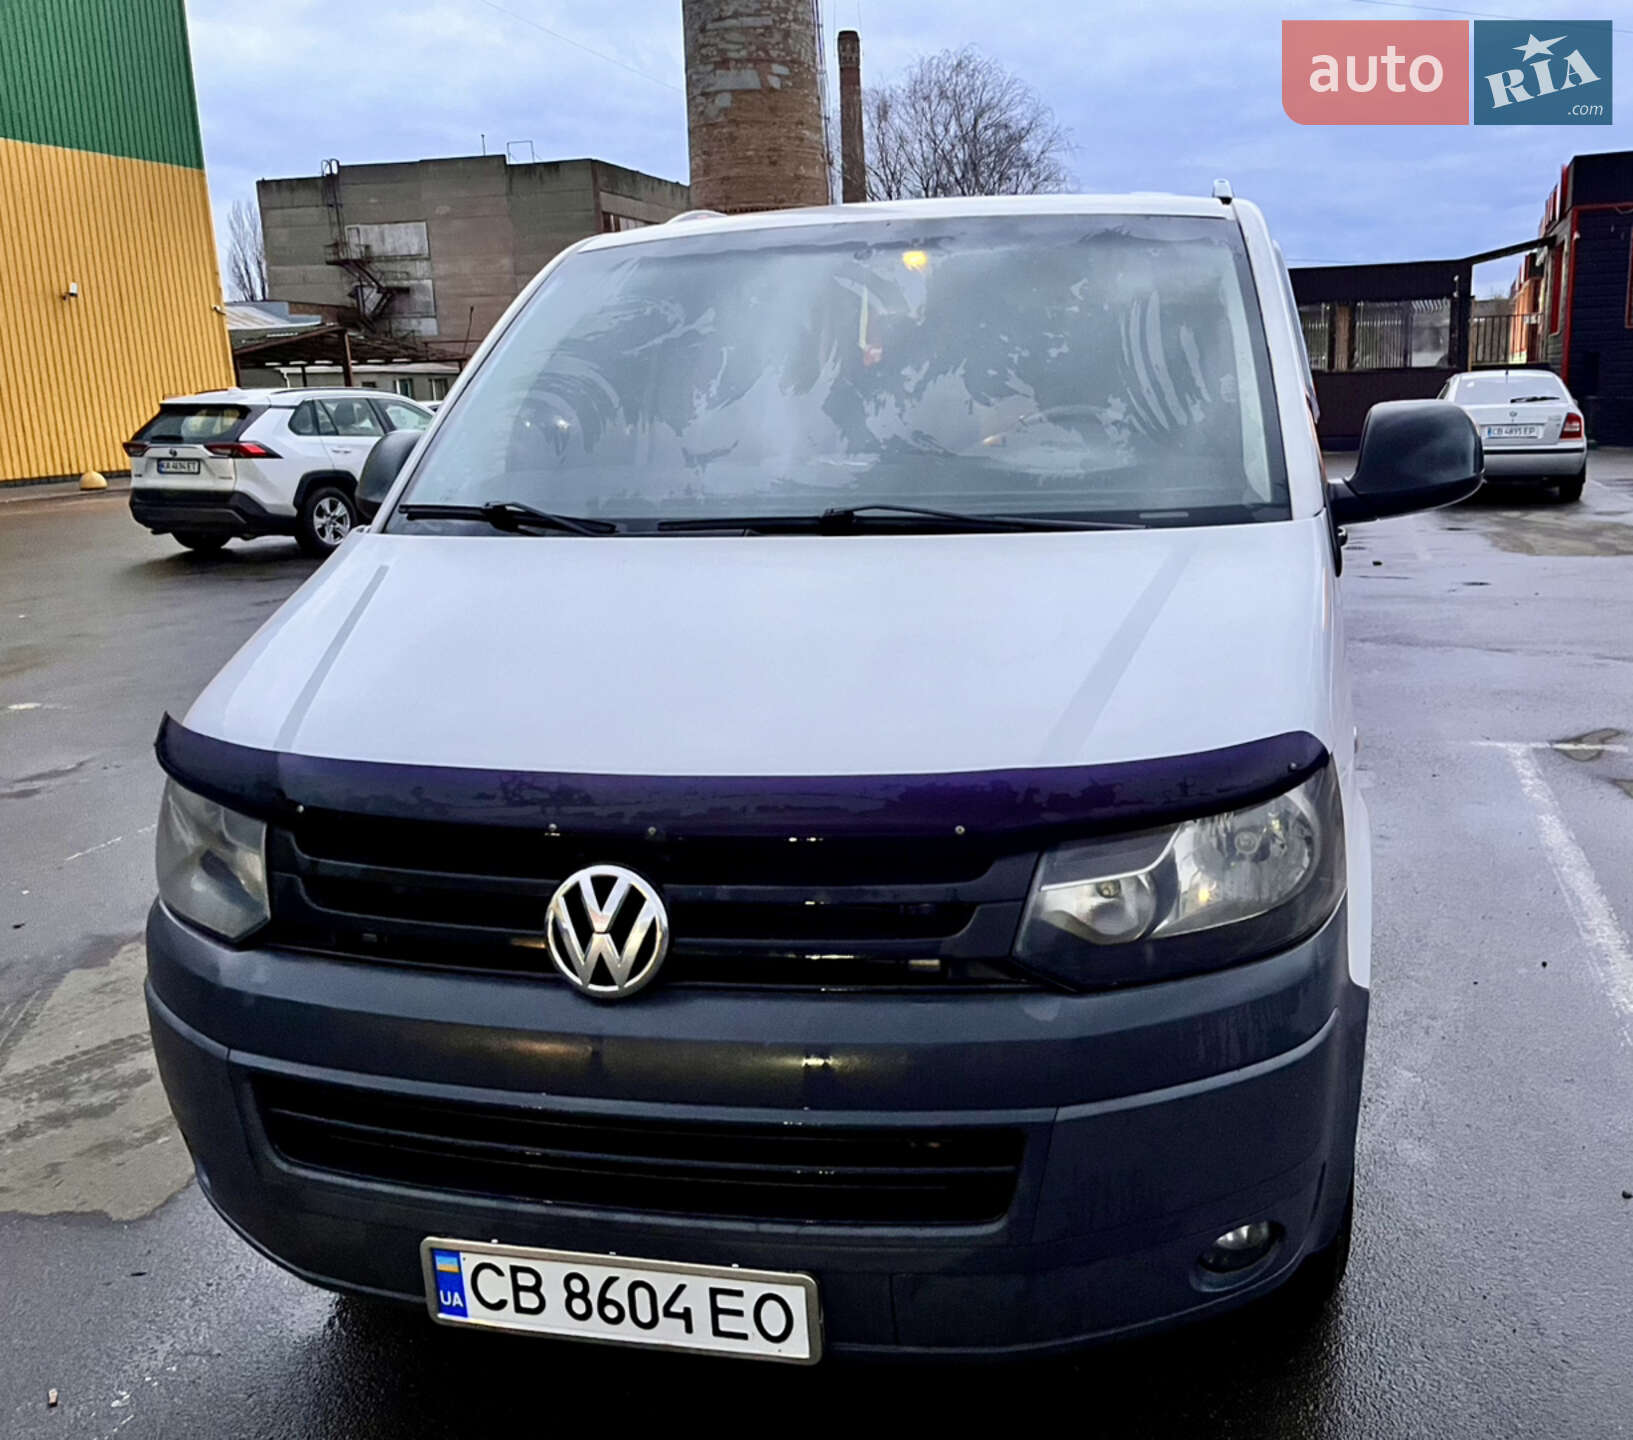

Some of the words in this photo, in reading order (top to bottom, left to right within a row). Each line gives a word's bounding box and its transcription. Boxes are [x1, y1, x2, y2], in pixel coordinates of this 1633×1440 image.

[440, 1289, 464, 1309] UA
[470, 1261, 546, 1315] CB
[563, 1271, 694, 1334] 8604
[708, 1286, 794, 1344] EO
